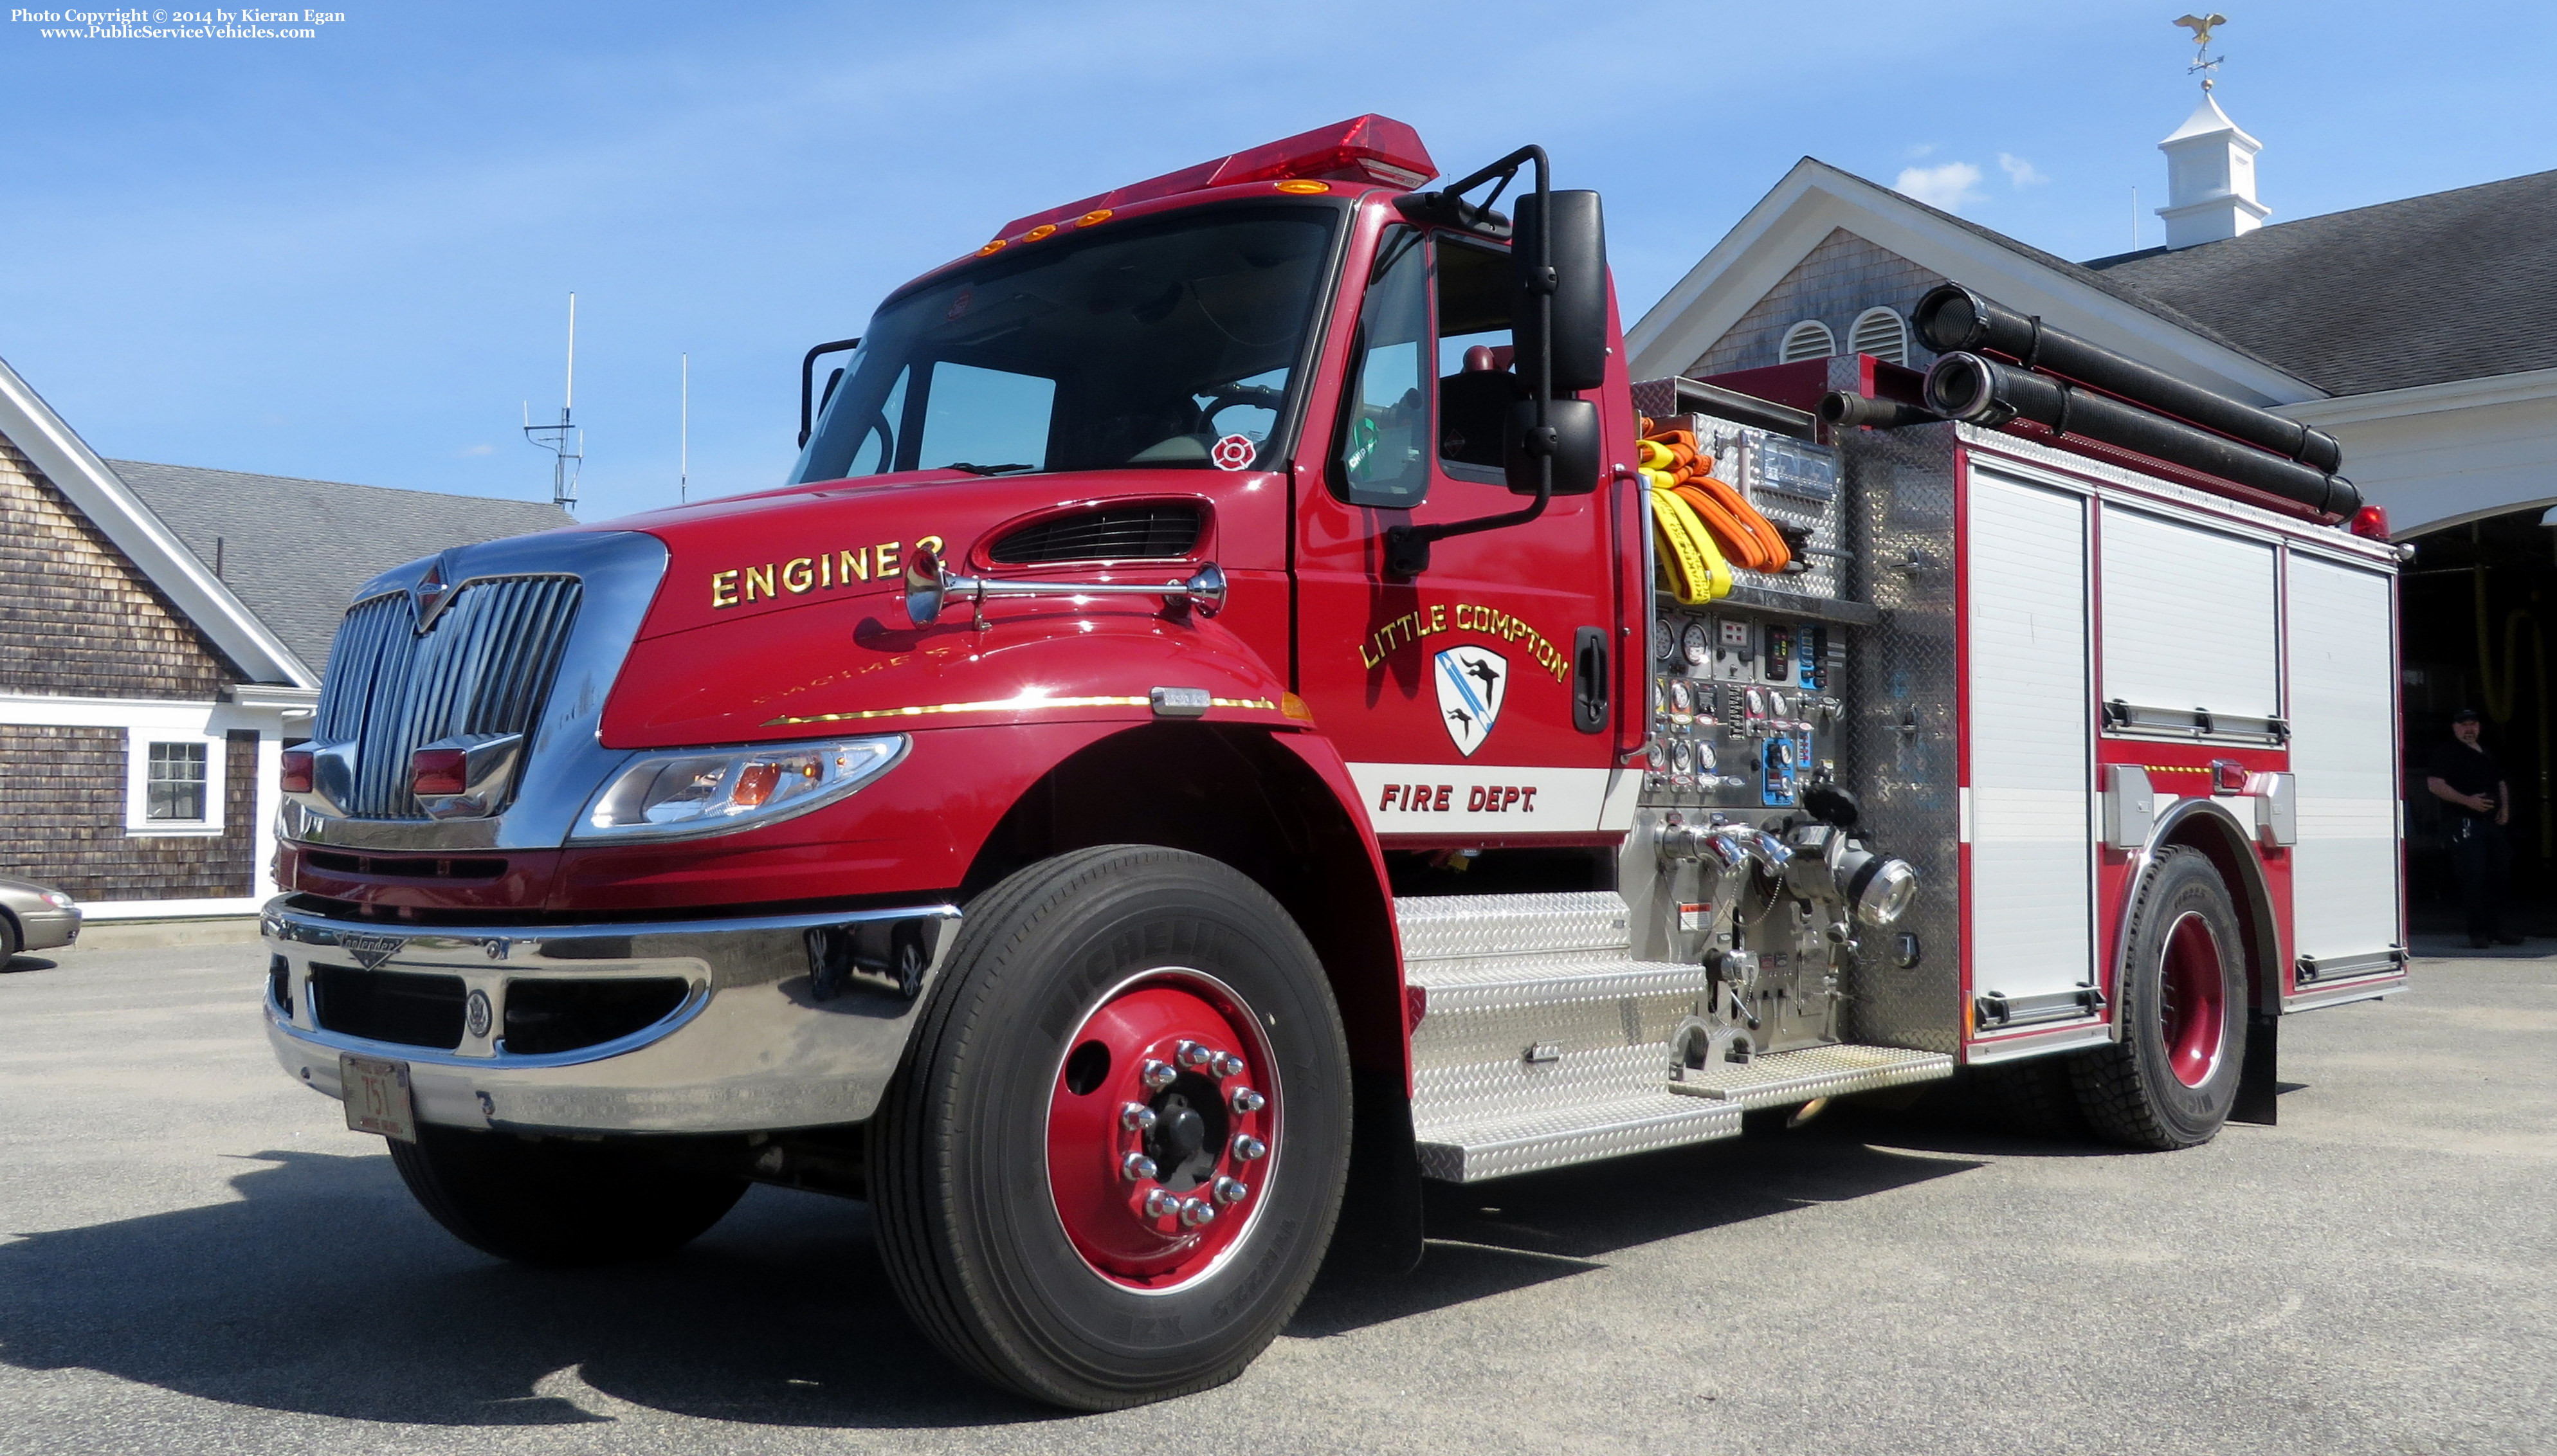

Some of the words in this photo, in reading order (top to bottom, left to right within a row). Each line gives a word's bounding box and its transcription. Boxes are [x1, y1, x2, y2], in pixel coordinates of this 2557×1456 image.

[712, 541, 901, 608] ENGINE
[1358, 604, 1447, 669] LITTLE
[1456, 603, 1570, 684] COMPTON
[1379, 784, 1453, 812] FIRE
[1467, 785, 1538, 812] DEPT.
[1039, 919, 1242, 1044] MICHELIN
